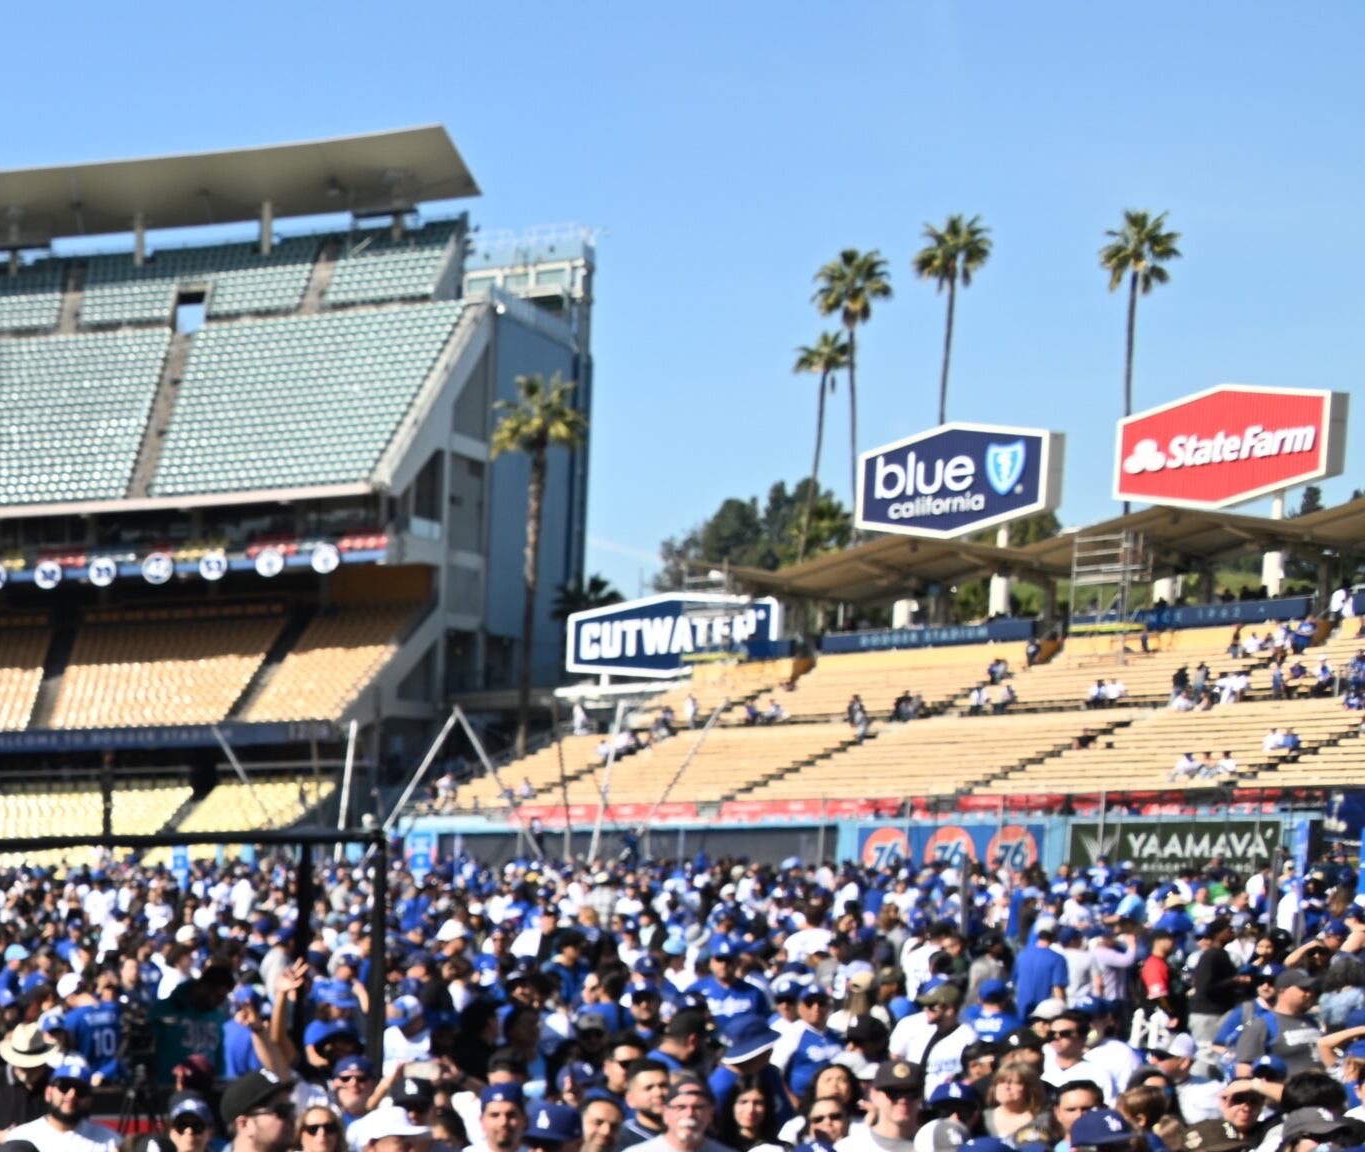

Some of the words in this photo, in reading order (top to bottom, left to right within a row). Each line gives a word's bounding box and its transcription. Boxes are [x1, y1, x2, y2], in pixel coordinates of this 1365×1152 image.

[874, 450, 975, 499] blue
[887, 492, 985, 520] california
[859, 632, 918, 647] DODGER
[923, 626, 989, 643] STADIUM
[63, 734, 84, 746] TO
[91, 731, 157, 745] DODGER
[872, 839, 902, 869] 76
[92, 1028, 117, 1058] 10
